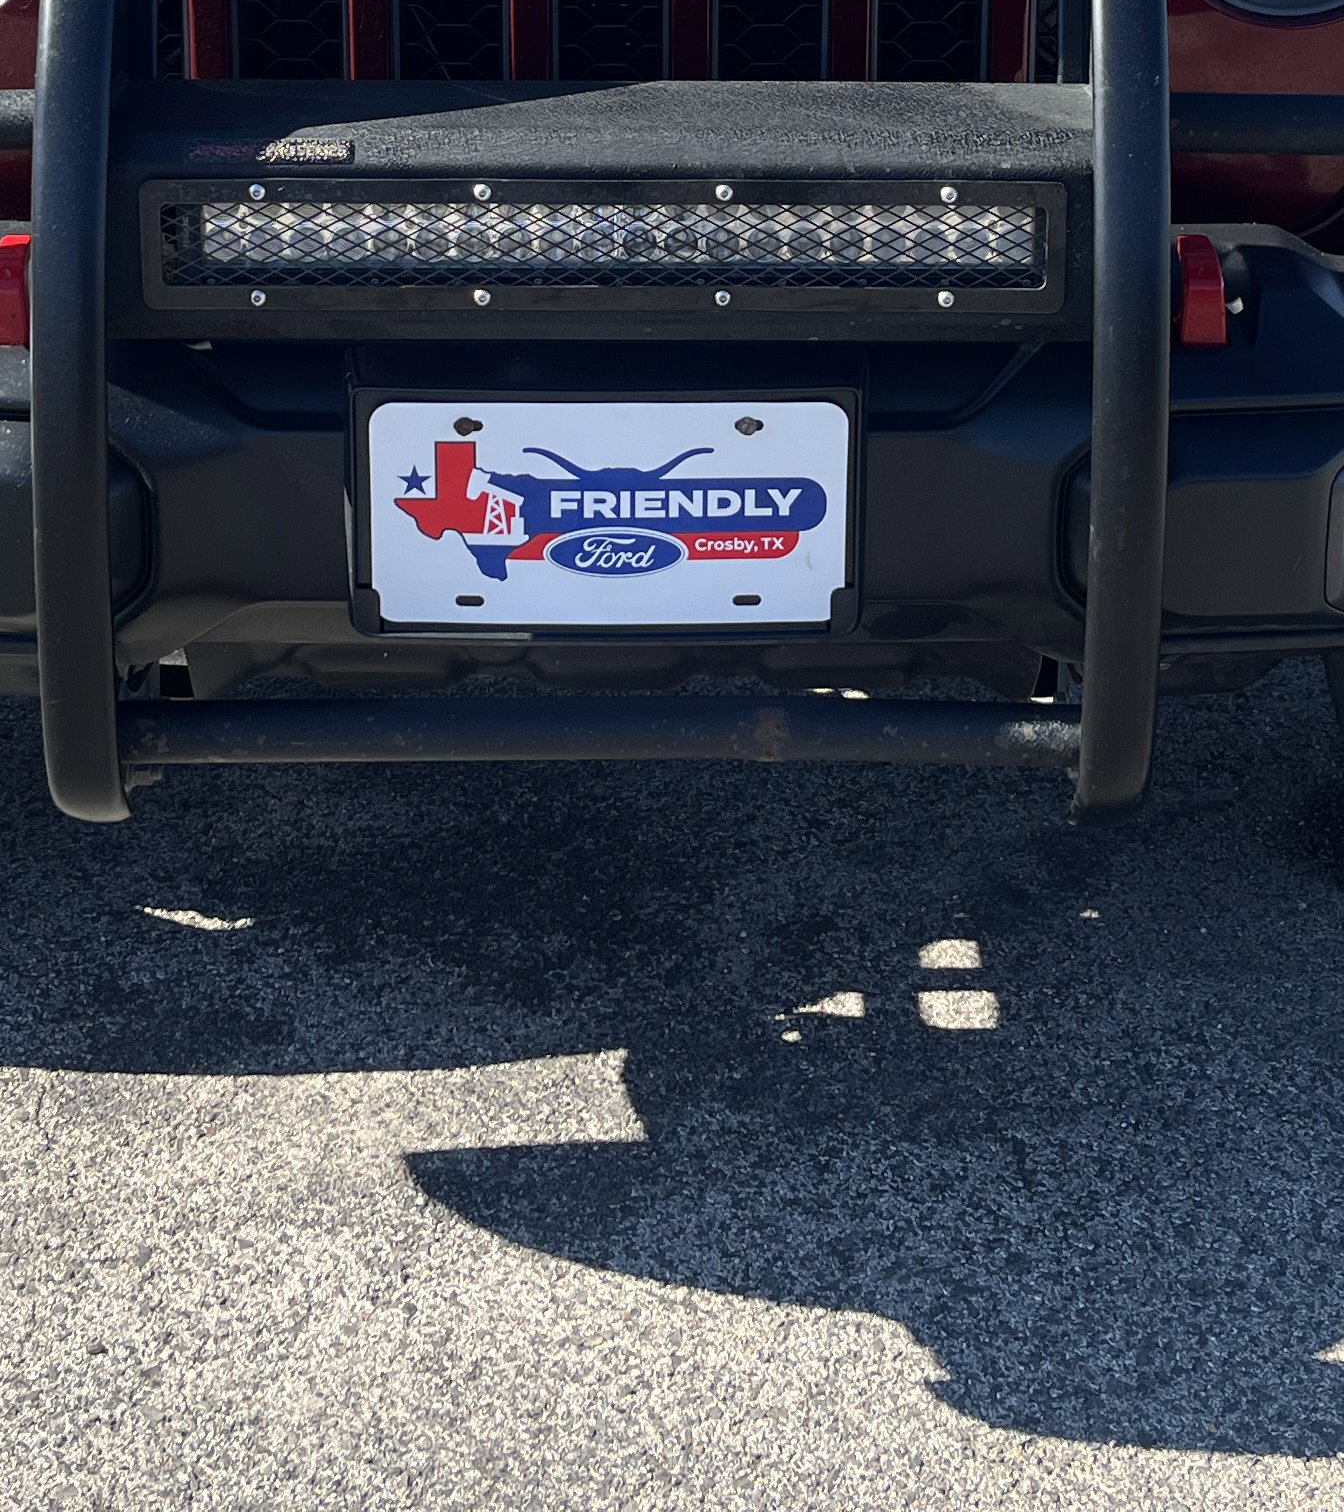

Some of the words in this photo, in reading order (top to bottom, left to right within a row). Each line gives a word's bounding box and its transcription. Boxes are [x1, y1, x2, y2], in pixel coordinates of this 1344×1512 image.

[550, 488, 803, 519] FRIENDLY
[574, 536, 656, 569] Ford
[694, 537, 759, 554] Crosby,
[761, 536, 785, 551] TX
